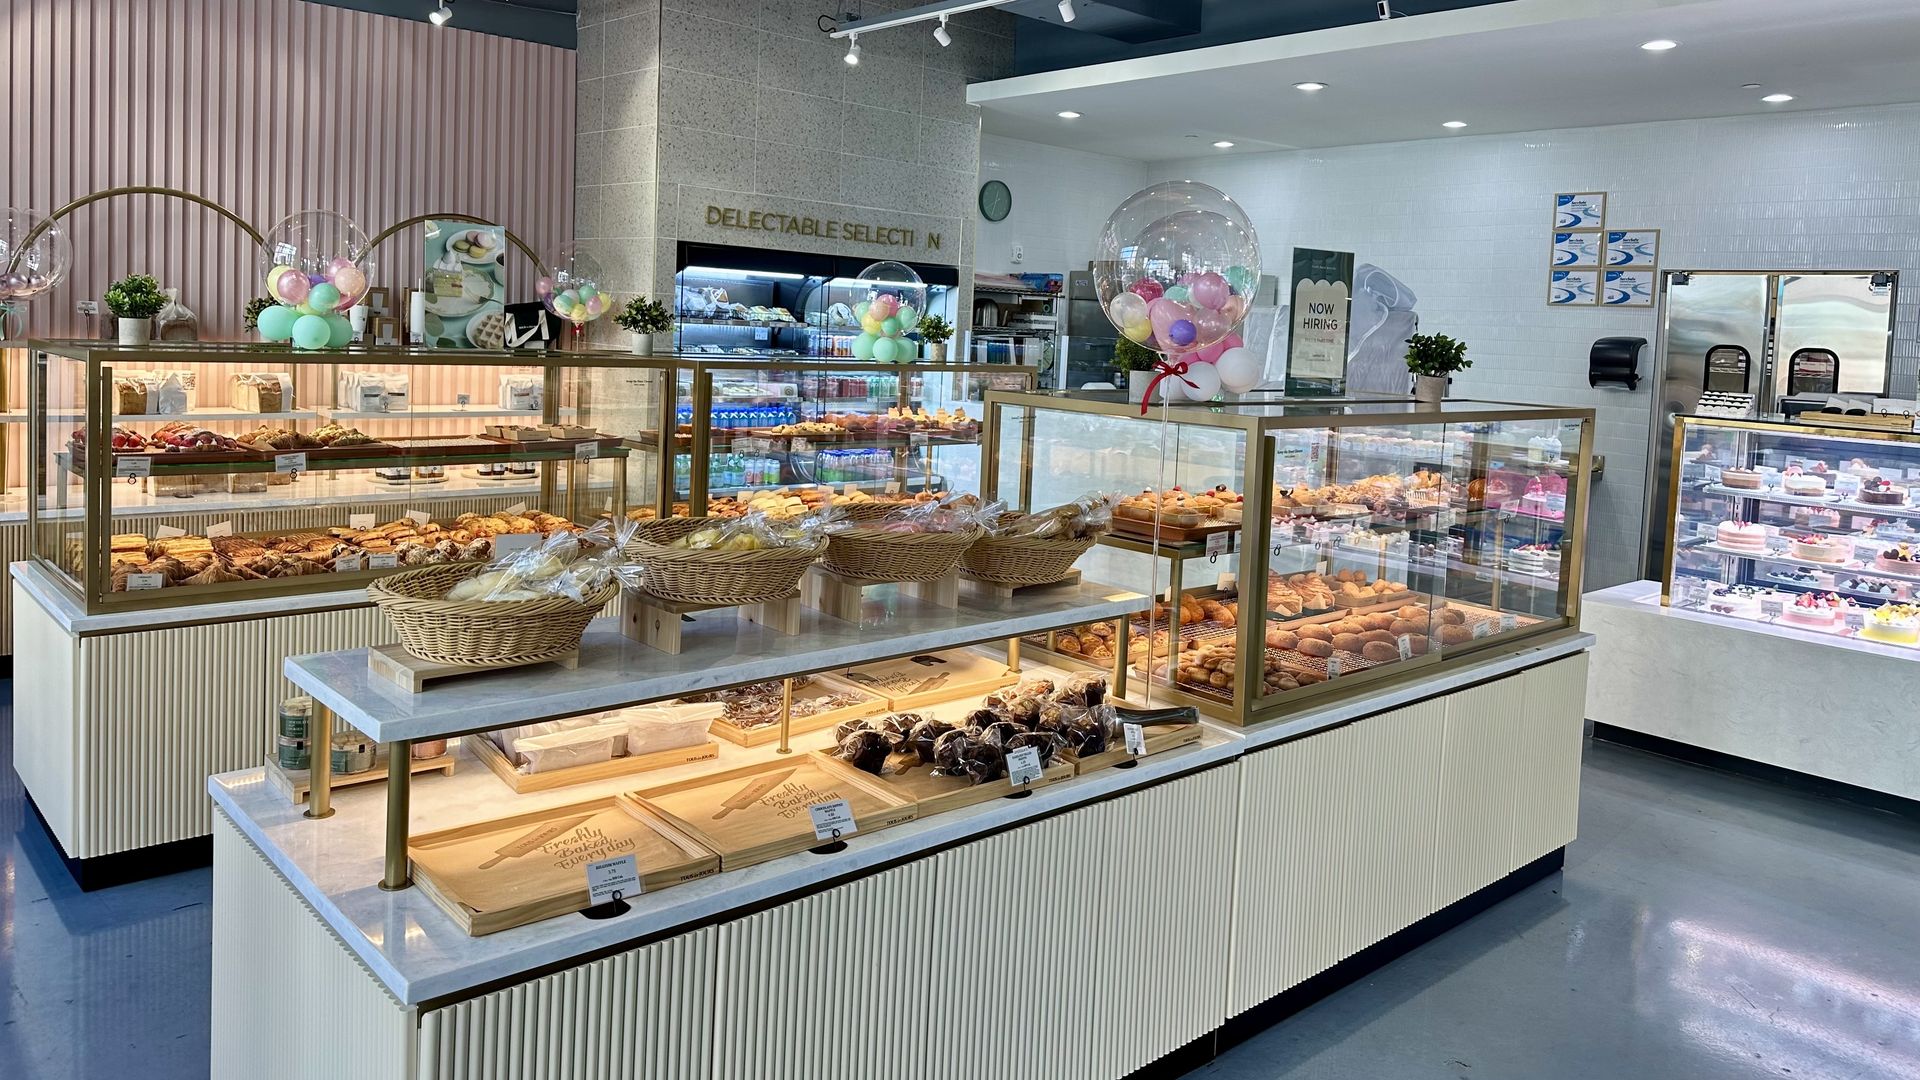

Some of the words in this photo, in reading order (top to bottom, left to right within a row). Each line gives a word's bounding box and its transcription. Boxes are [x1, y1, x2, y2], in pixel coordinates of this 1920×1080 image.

[705, 205, 838, 239] DELECTABLE
[1308, 302, 1335, 315] NOW
[1303, 318, 1338, 331] HIRING
[759, 782, 810, 806] Freshly
[541, 826, 604, 854] Freshly
